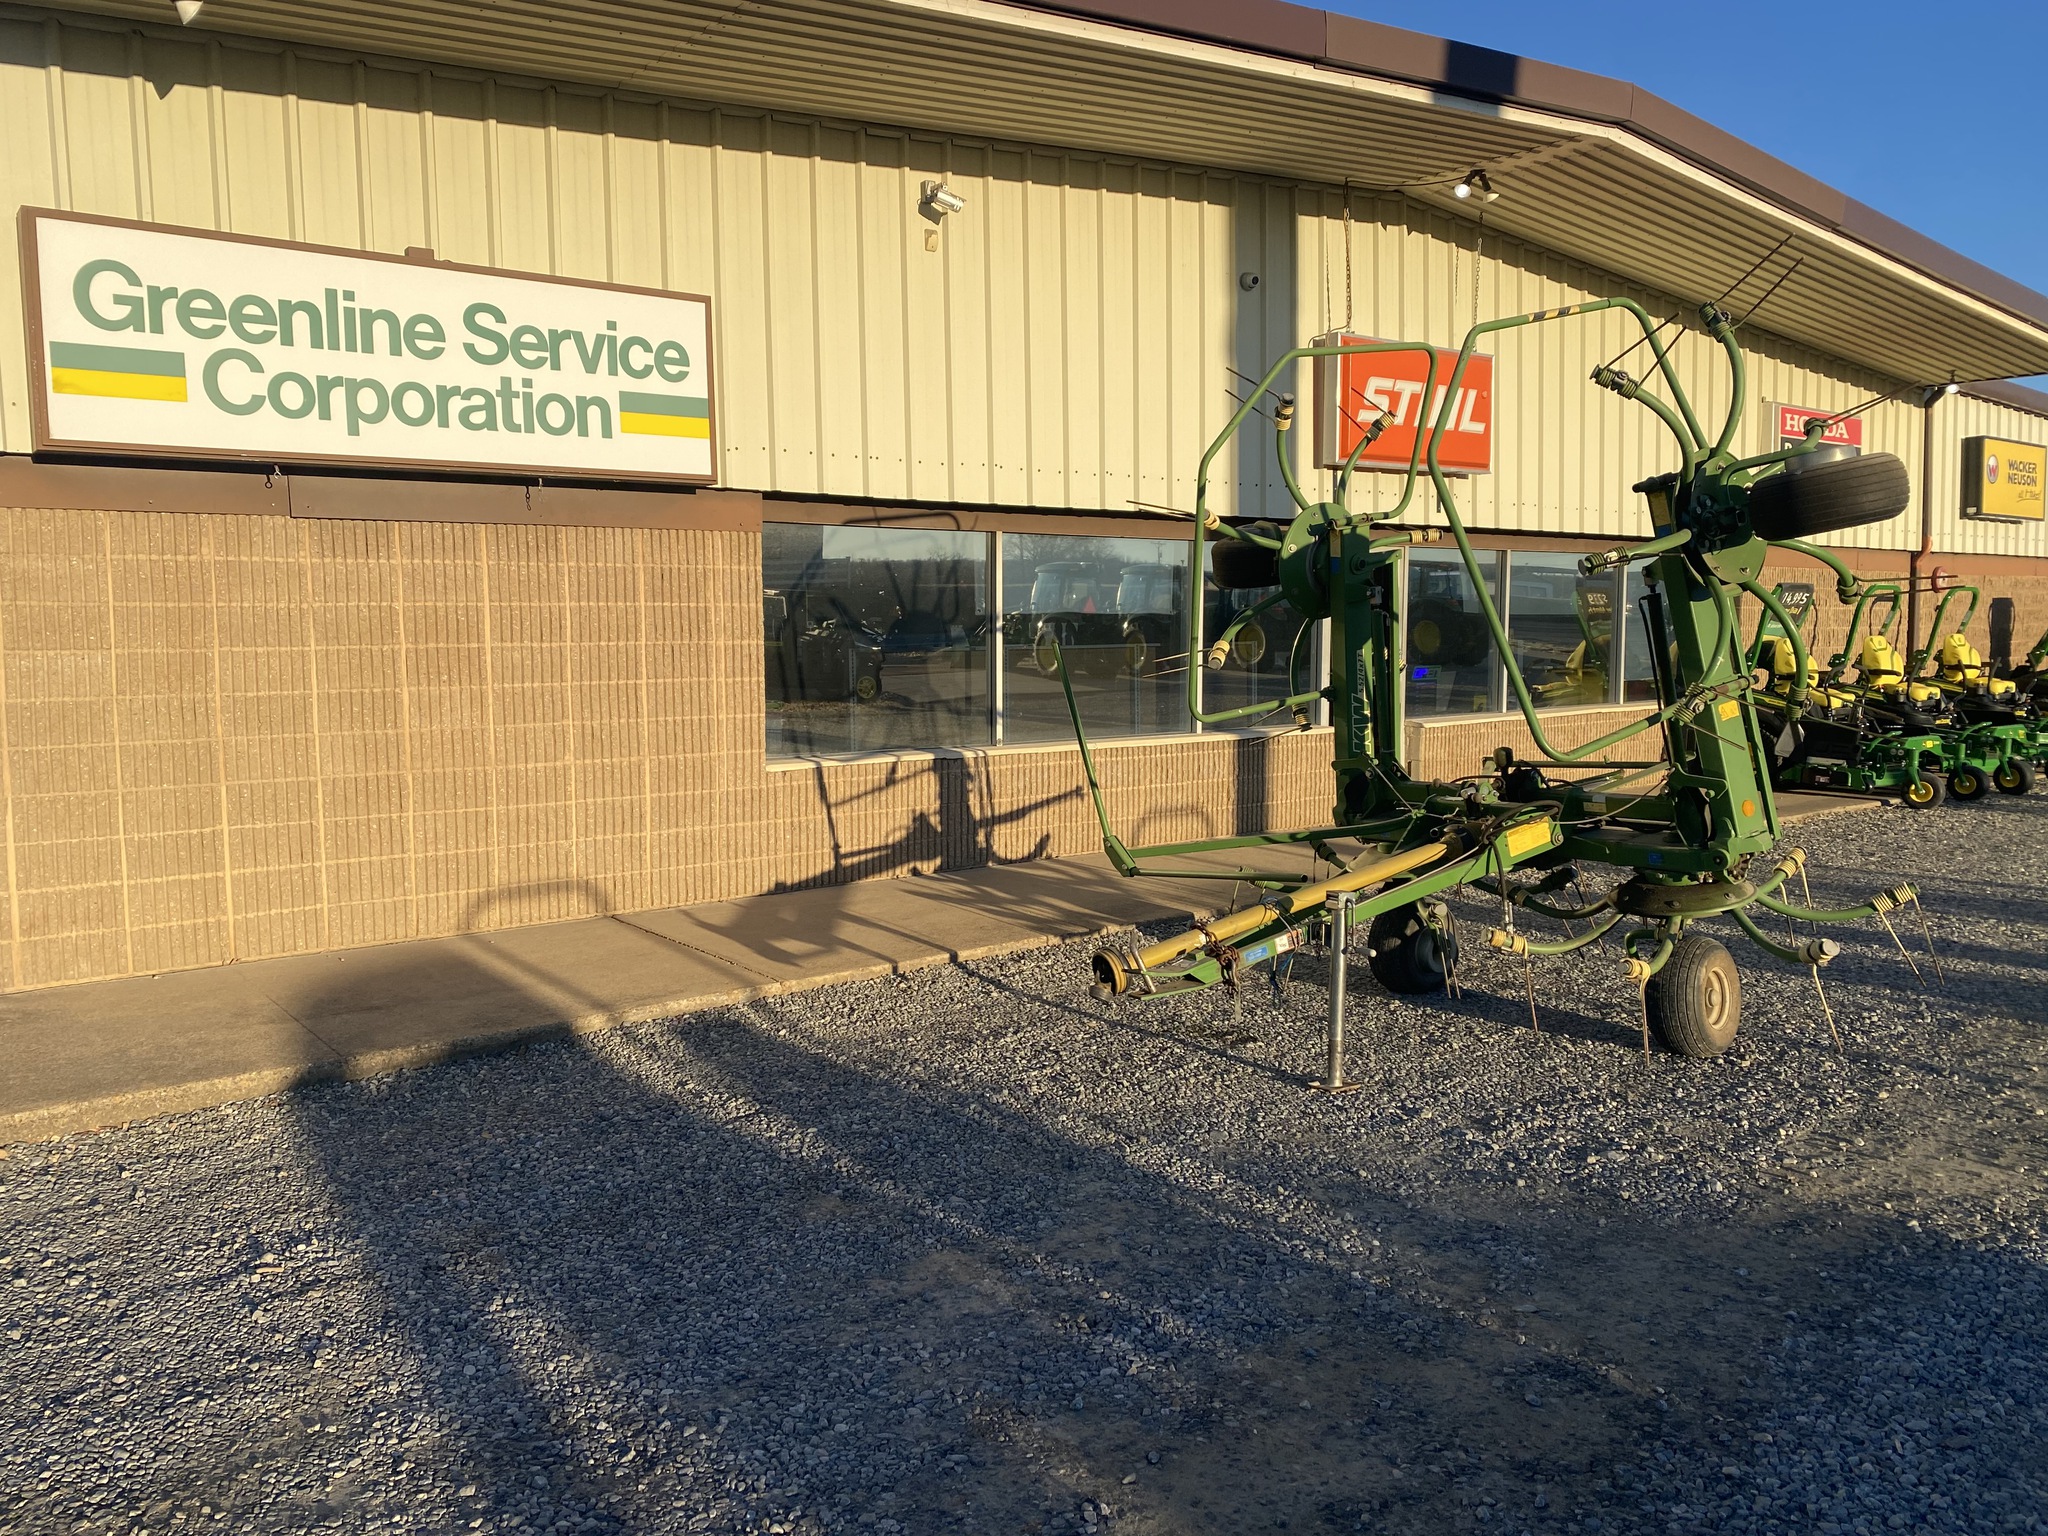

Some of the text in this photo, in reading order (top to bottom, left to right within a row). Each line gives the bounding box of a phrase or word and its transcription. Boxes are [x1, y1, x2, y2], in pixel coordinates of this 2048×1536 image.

[73, 259, 690, 383] Greenline Service
[202, 347, 613, 439] Corporation
[1785, 413, 1850, 439] HODA
[2008, 459, 2038, 474] WACKER
[2008, 472, 2038, 487] NEUSON
[1351, 693, 1371, 754] KW
